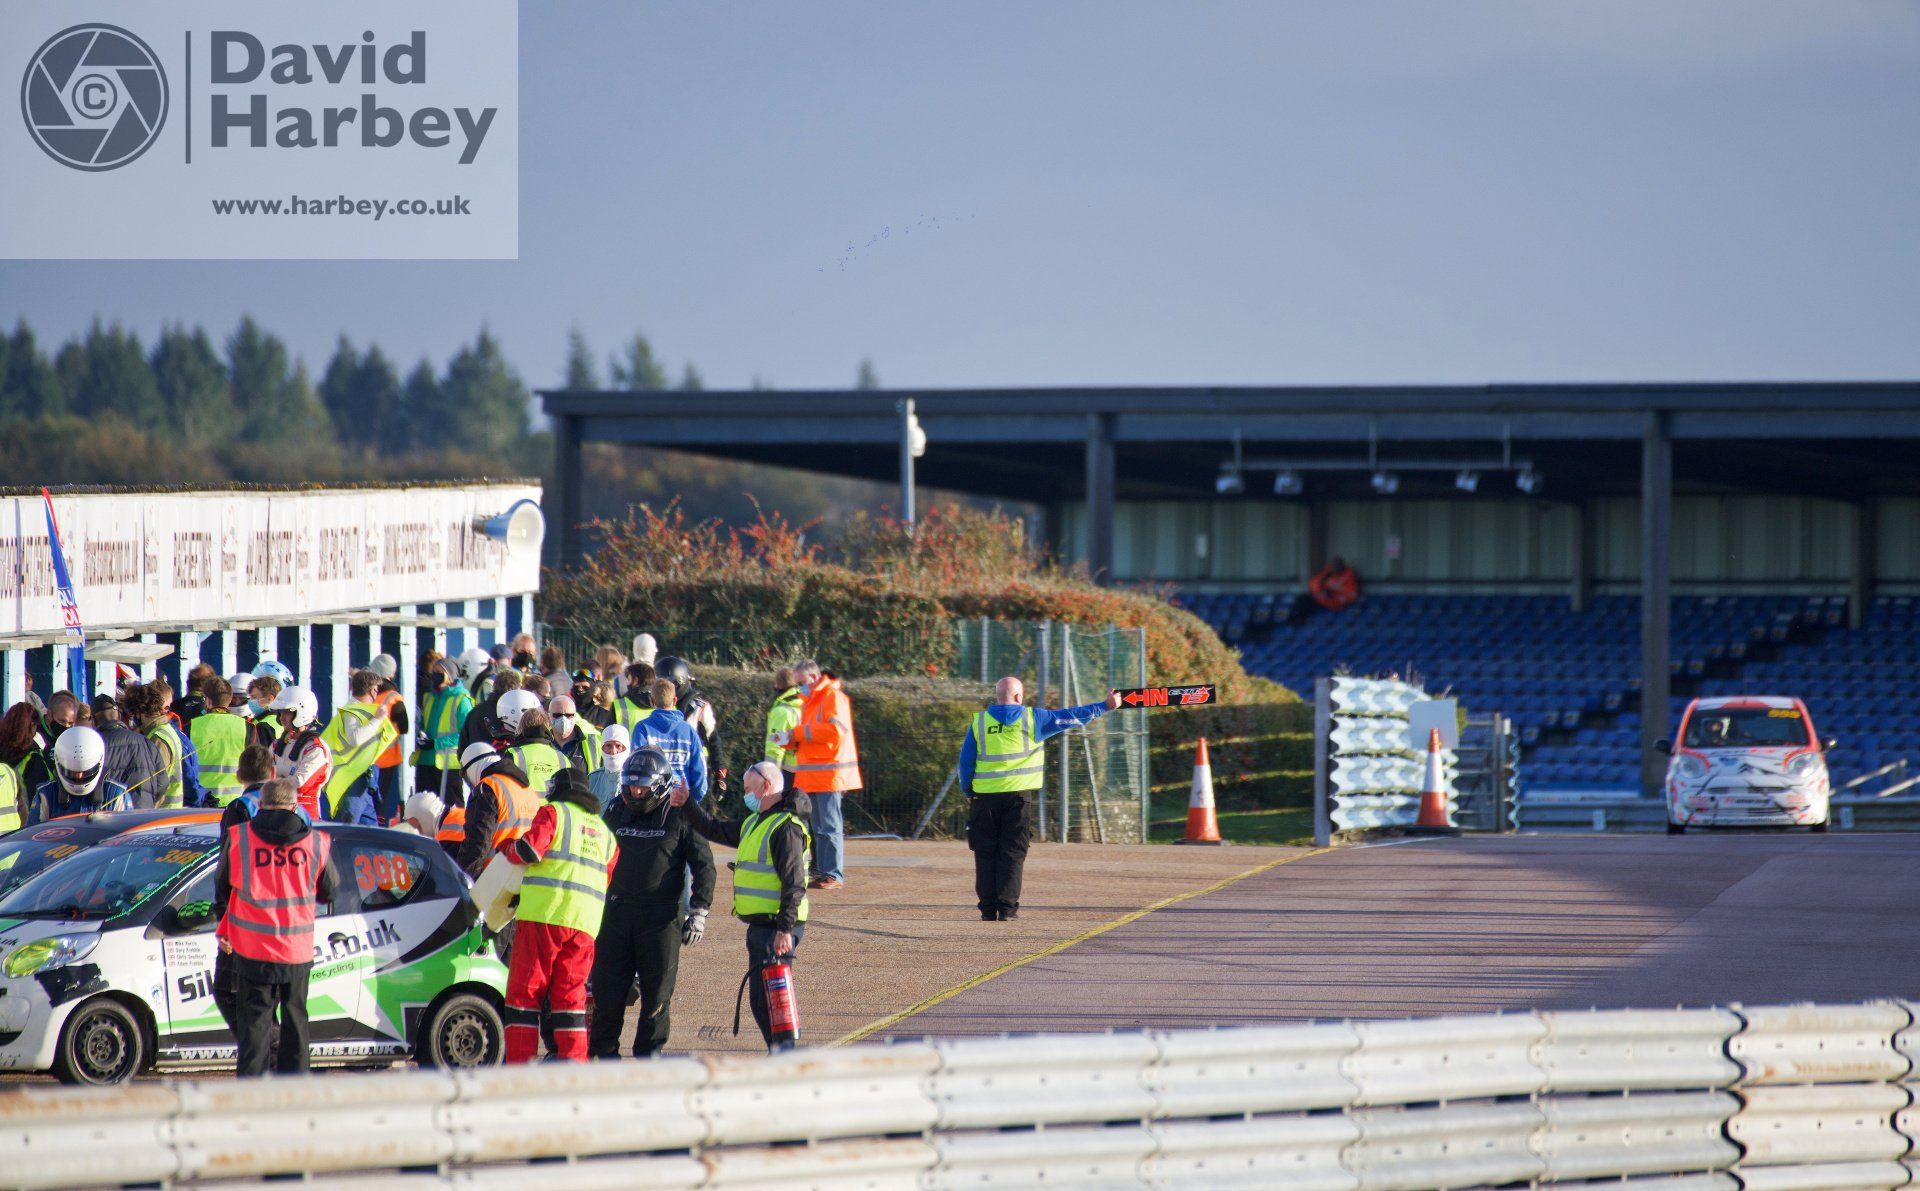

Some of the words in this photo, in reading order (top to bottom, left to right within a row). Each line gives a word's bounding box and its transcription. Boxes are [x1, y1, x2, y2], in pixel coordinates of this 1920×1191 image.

[1143, 687, 1169, 707] IN
[354, 854, 413, 892] 398
[311, 961, 355, 980] recycling
